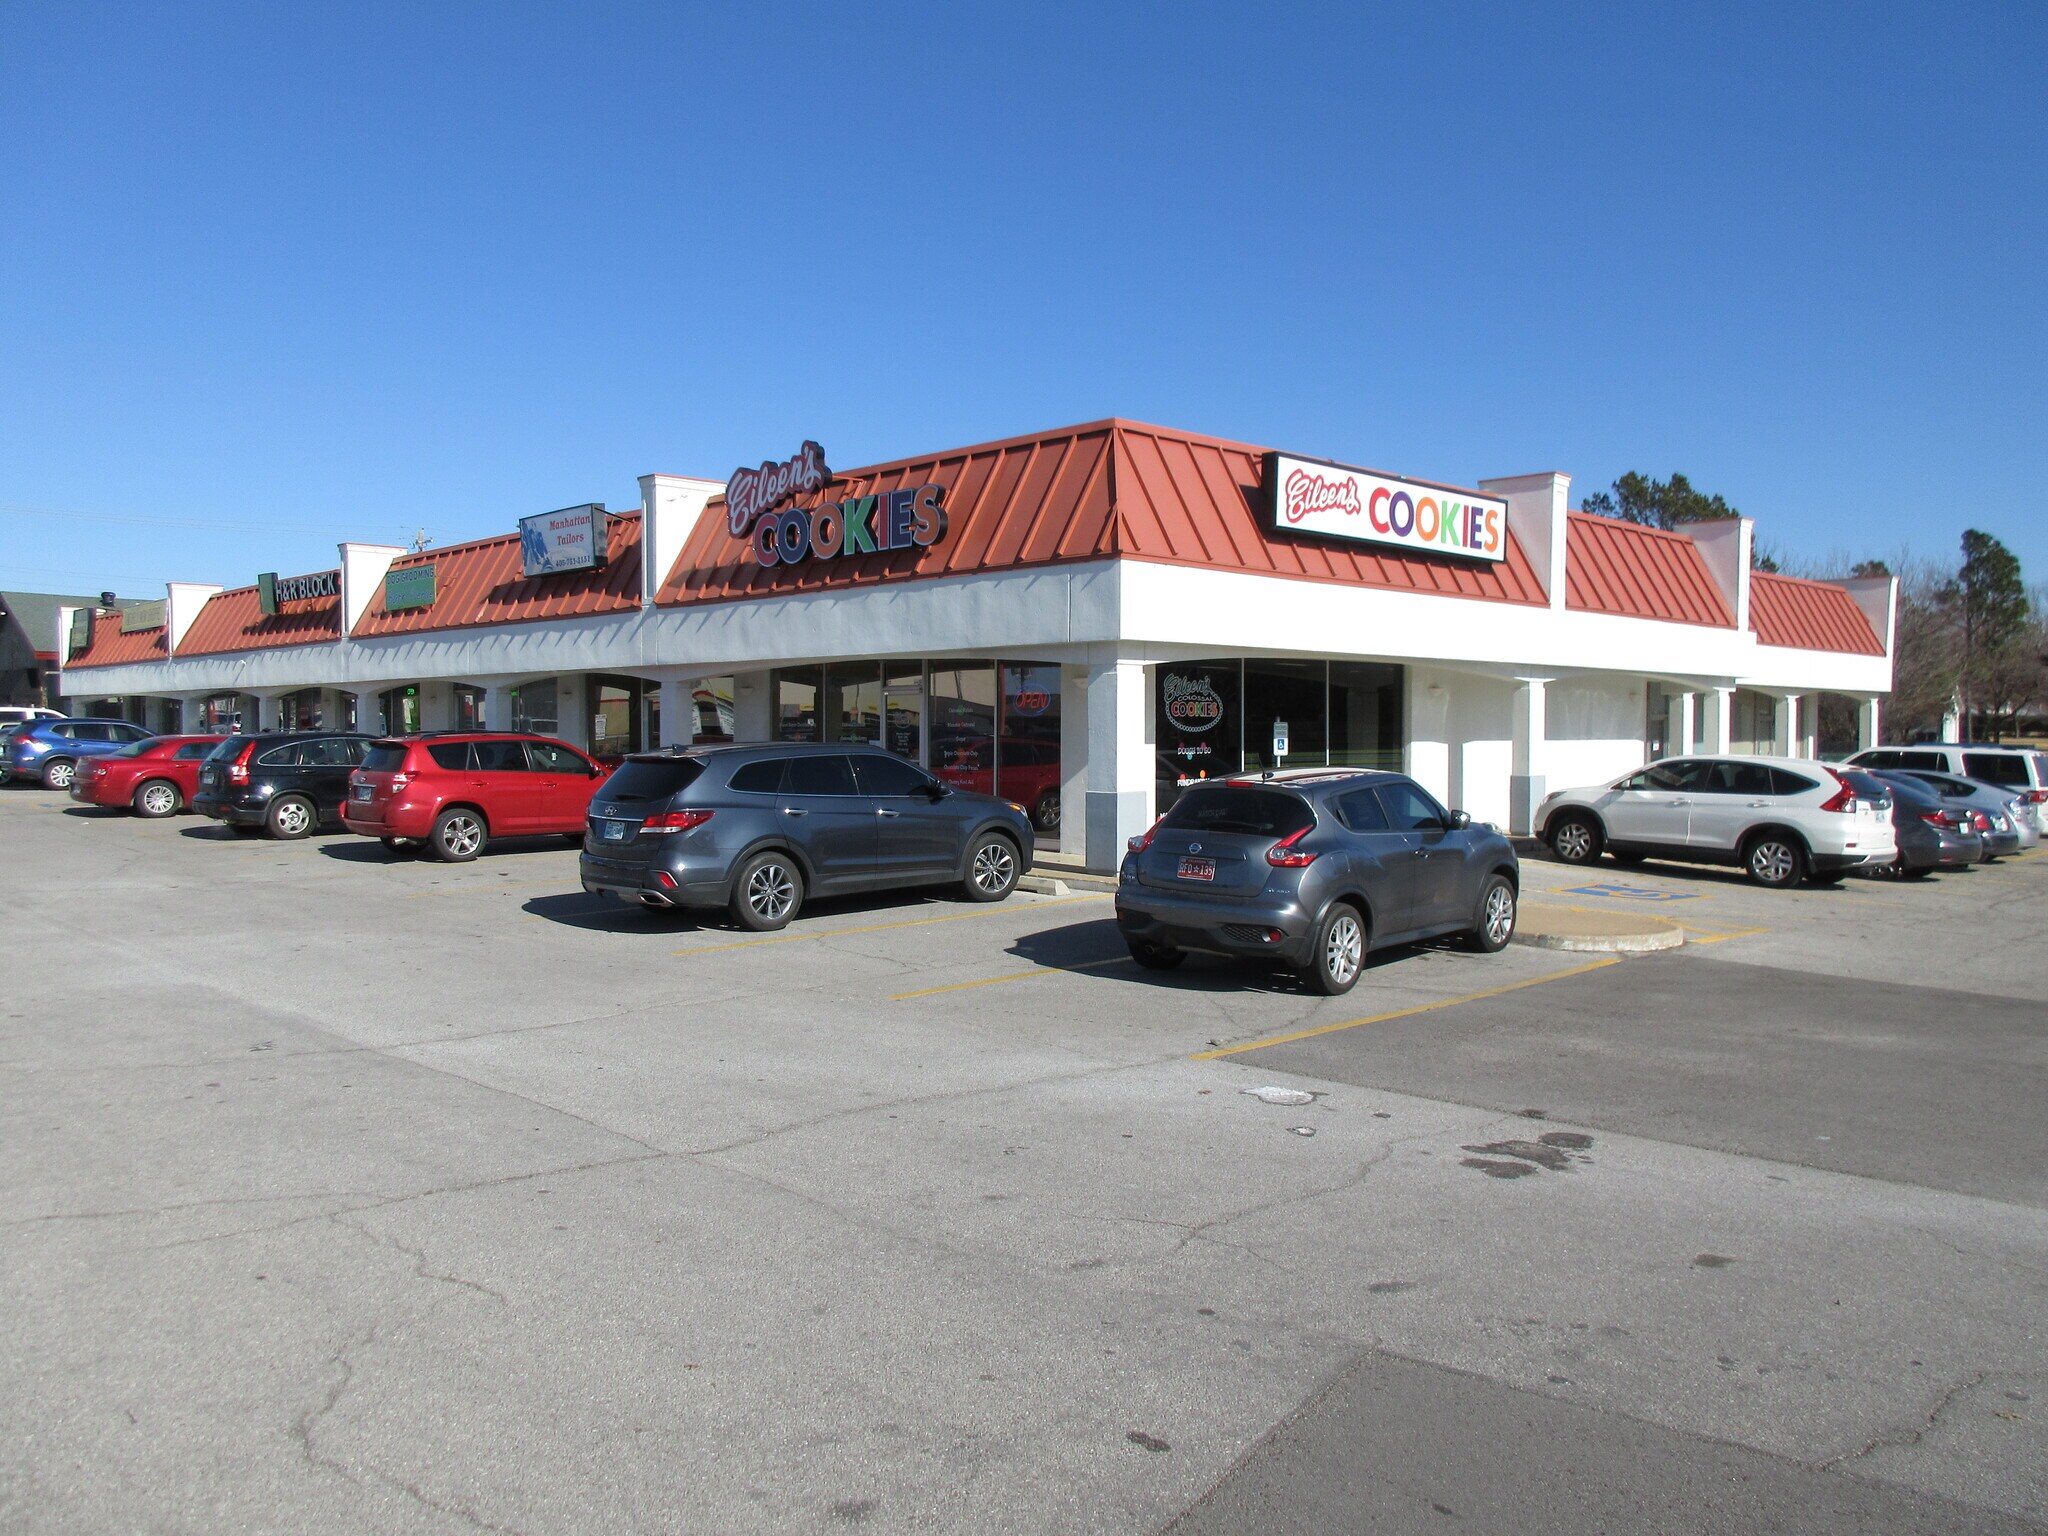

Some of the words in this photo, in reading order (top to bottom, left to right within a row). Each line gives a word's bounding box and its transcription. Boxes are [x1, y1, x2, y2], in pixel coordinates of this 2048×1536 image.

[727, 446, 822, 534] Eileen's
[1286, 468, 1361, 523] Eileen's
[1369, 487, 1499, 553] COOKIES
[549, 515, 591, 531] Manhattan
[753, 484, 941, 567] COOKIES
[557, 533, 584, 546] Tailors
[401, 568, 434, 582] GROOMING
[275, 578, 298, 602] H&R
[300, 573, 336, 599] BLOCK
[1015, 692, 1047, 708] OPEN
[1171, 701, 1218, 717] COOKIES
